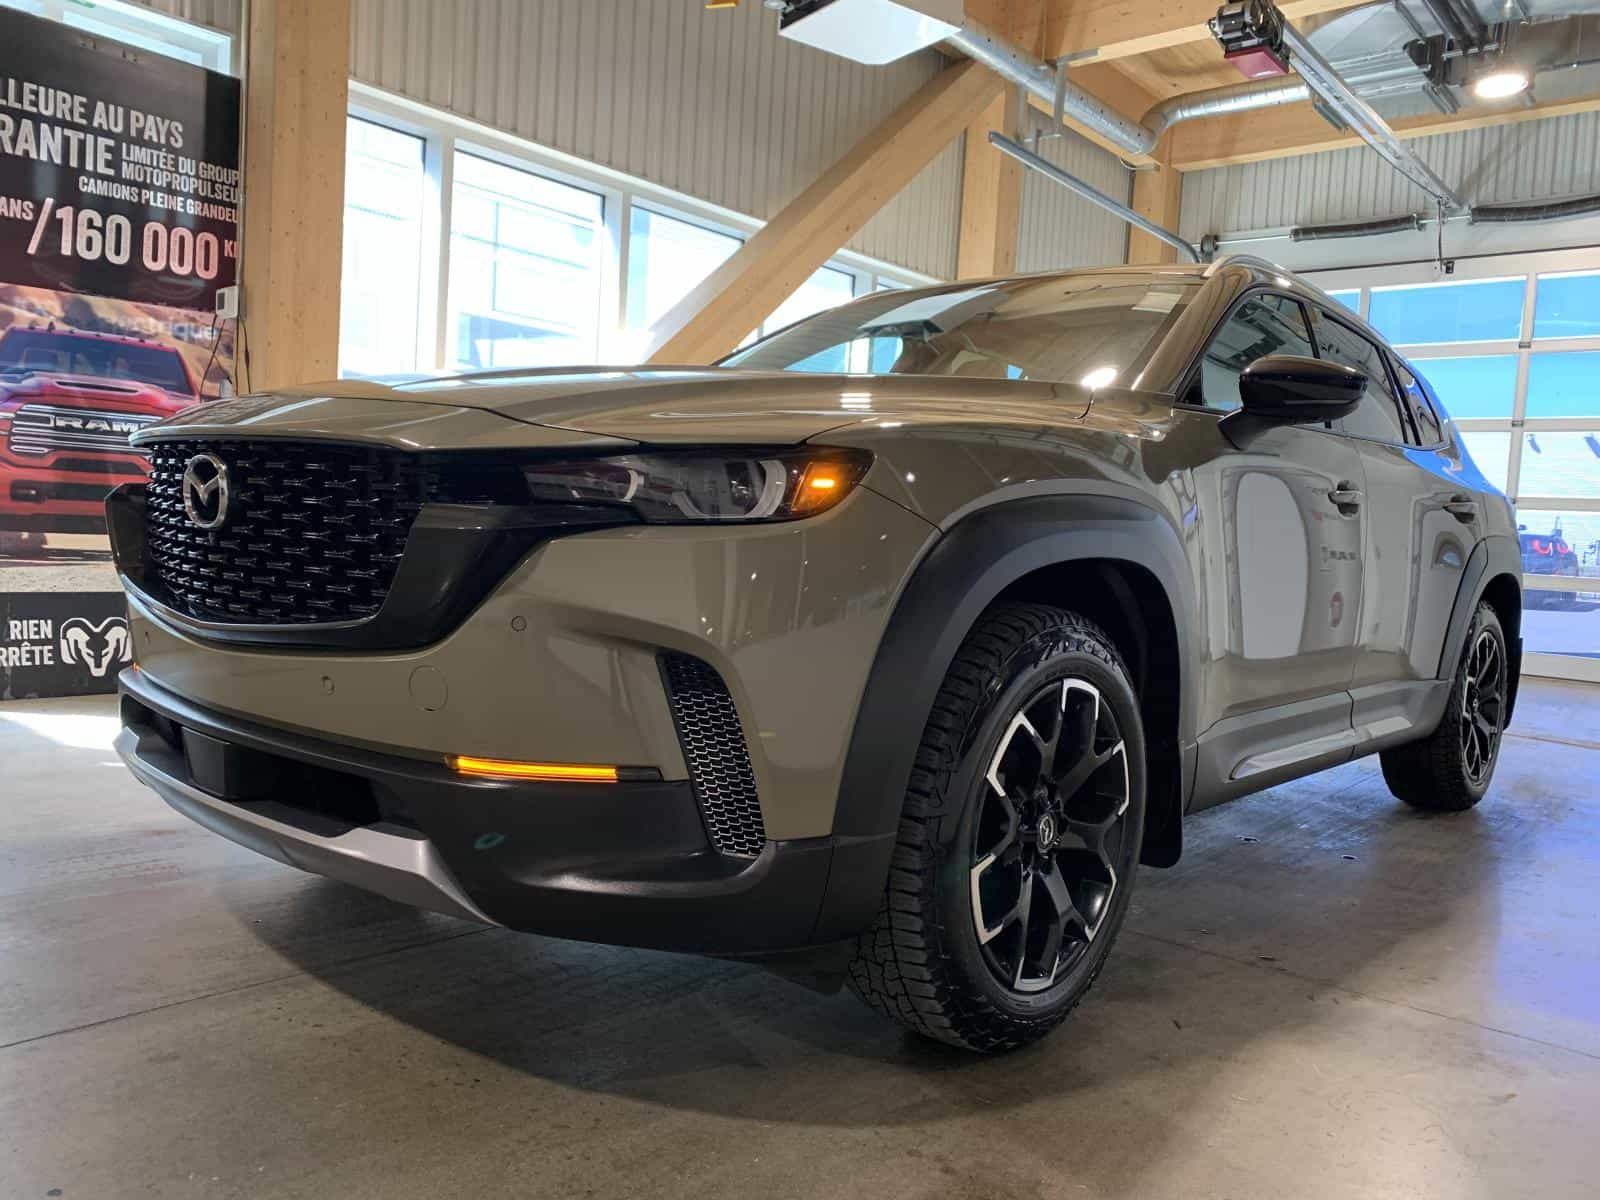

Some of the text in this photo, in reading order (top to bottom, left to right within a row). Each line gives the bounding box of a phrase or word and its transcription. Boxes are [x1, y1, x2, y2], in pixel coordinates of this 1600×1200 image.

[0, 78, 184, 149] LEURE AU PAYS
[121, 142, 176, 171] LIMITÉE
[178, 156, 196, 176] DU
[78, 175, 139, 203] CAMIONS
[140, 189, 185, 212] PLEINE
[0, 196, 34, 221] ANS
[142, 221, 219, 280] 000
[55, 416, 139, 433] RAM
[9, 619, 53, 640] RIEN
